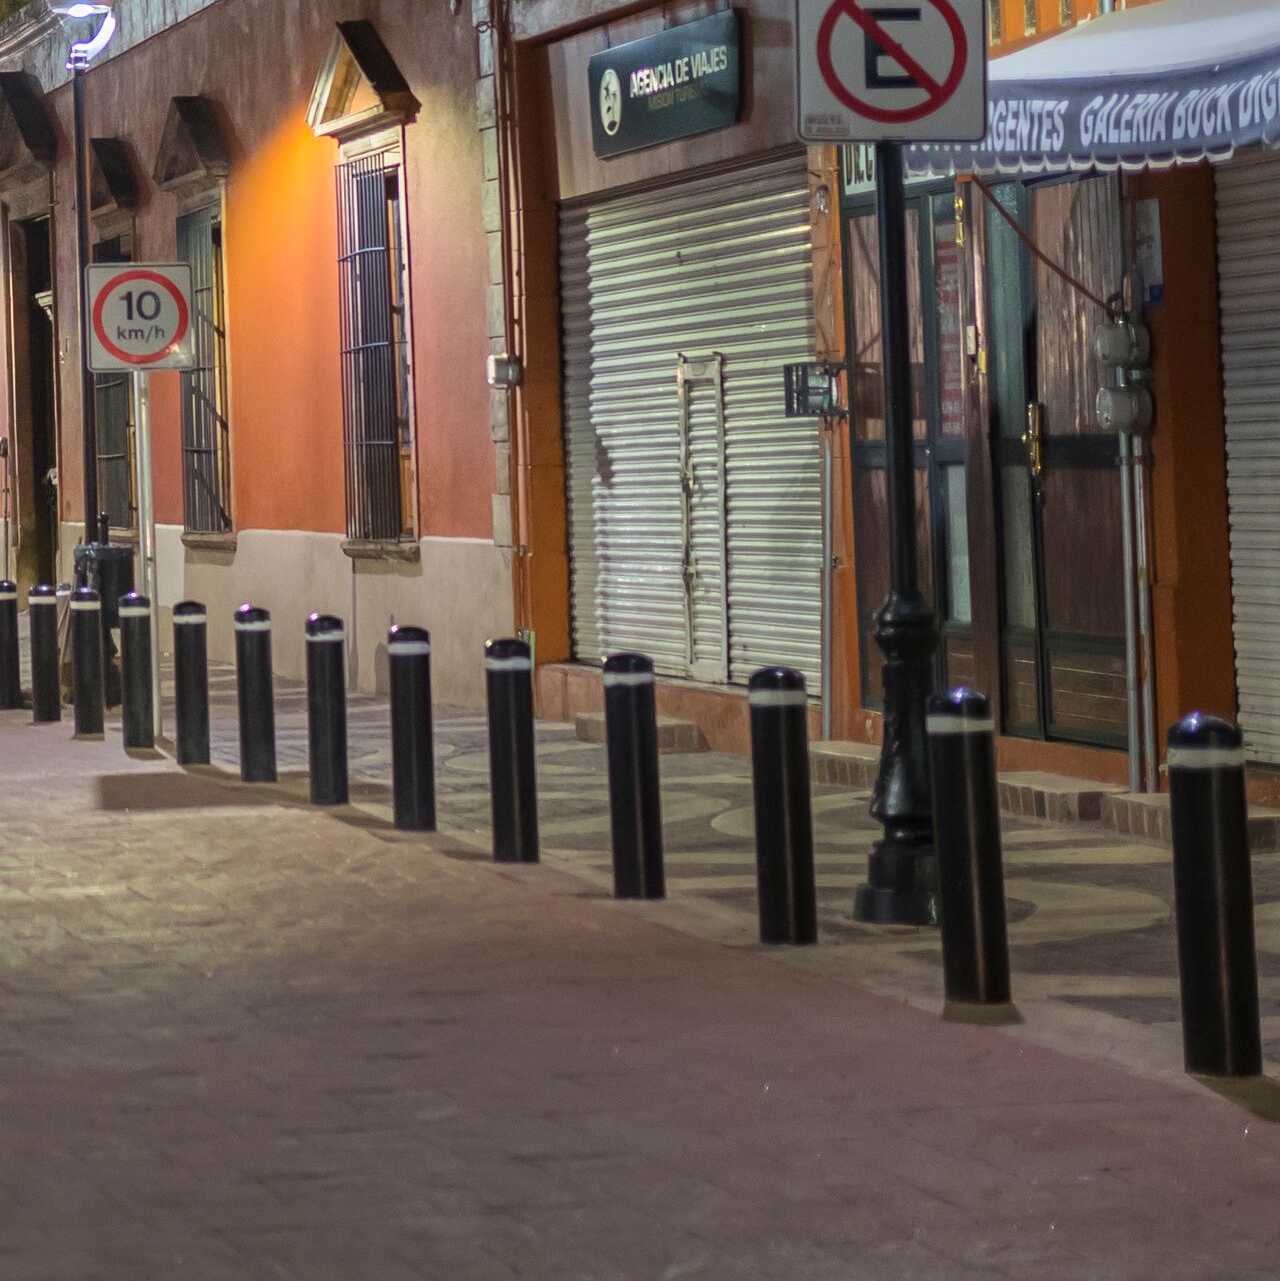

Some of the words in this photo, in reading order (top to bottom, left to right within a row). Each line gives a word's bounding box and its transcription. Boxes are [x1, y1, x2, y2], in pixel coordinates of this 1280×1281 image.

[630, 63, 674, 98] AGENCIA
[675, 57, 689, 84] DE
[691, 45, 728, 79] VIAJES
[862, 7, 922, 89] E
[1080, 90, 1179, 147] GALERIA
[1172, 79, 1244, 139] BUCK
[1238, 68, 1280, 128] DIG
[119, 290, 161, 321] 10
[117, 326, 165, 343] km/h
